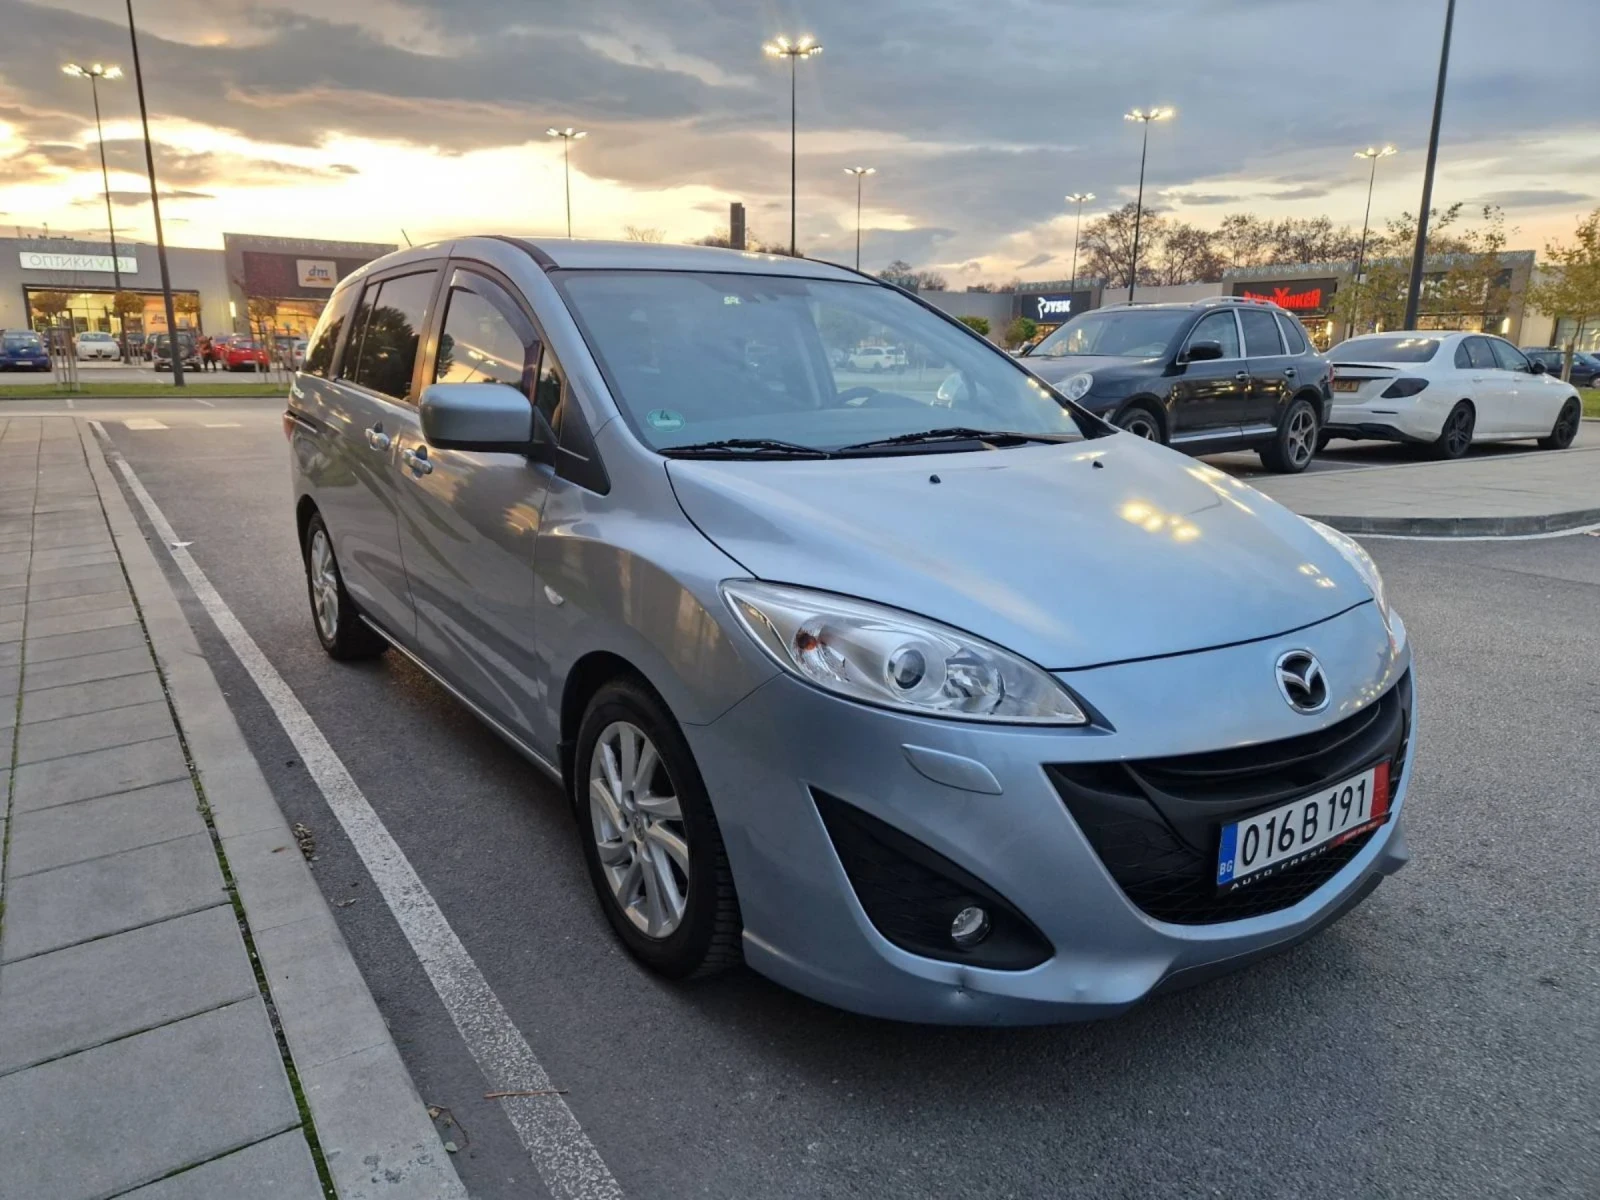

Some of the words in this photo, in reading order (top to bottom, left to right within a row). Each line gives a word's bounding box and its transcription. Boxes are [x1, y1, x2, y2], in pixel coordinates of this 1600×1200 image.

[29, 254, 93, 268] ОПТИКИ
[307, 265, 328, 277] dm
[1043, 300, 1071, 313] JYSK
[1220, 859, 1234, 876] BG
[1230, 869, 1273, 891] AUTO
[1281, 846, 1327, 870] FRESH
